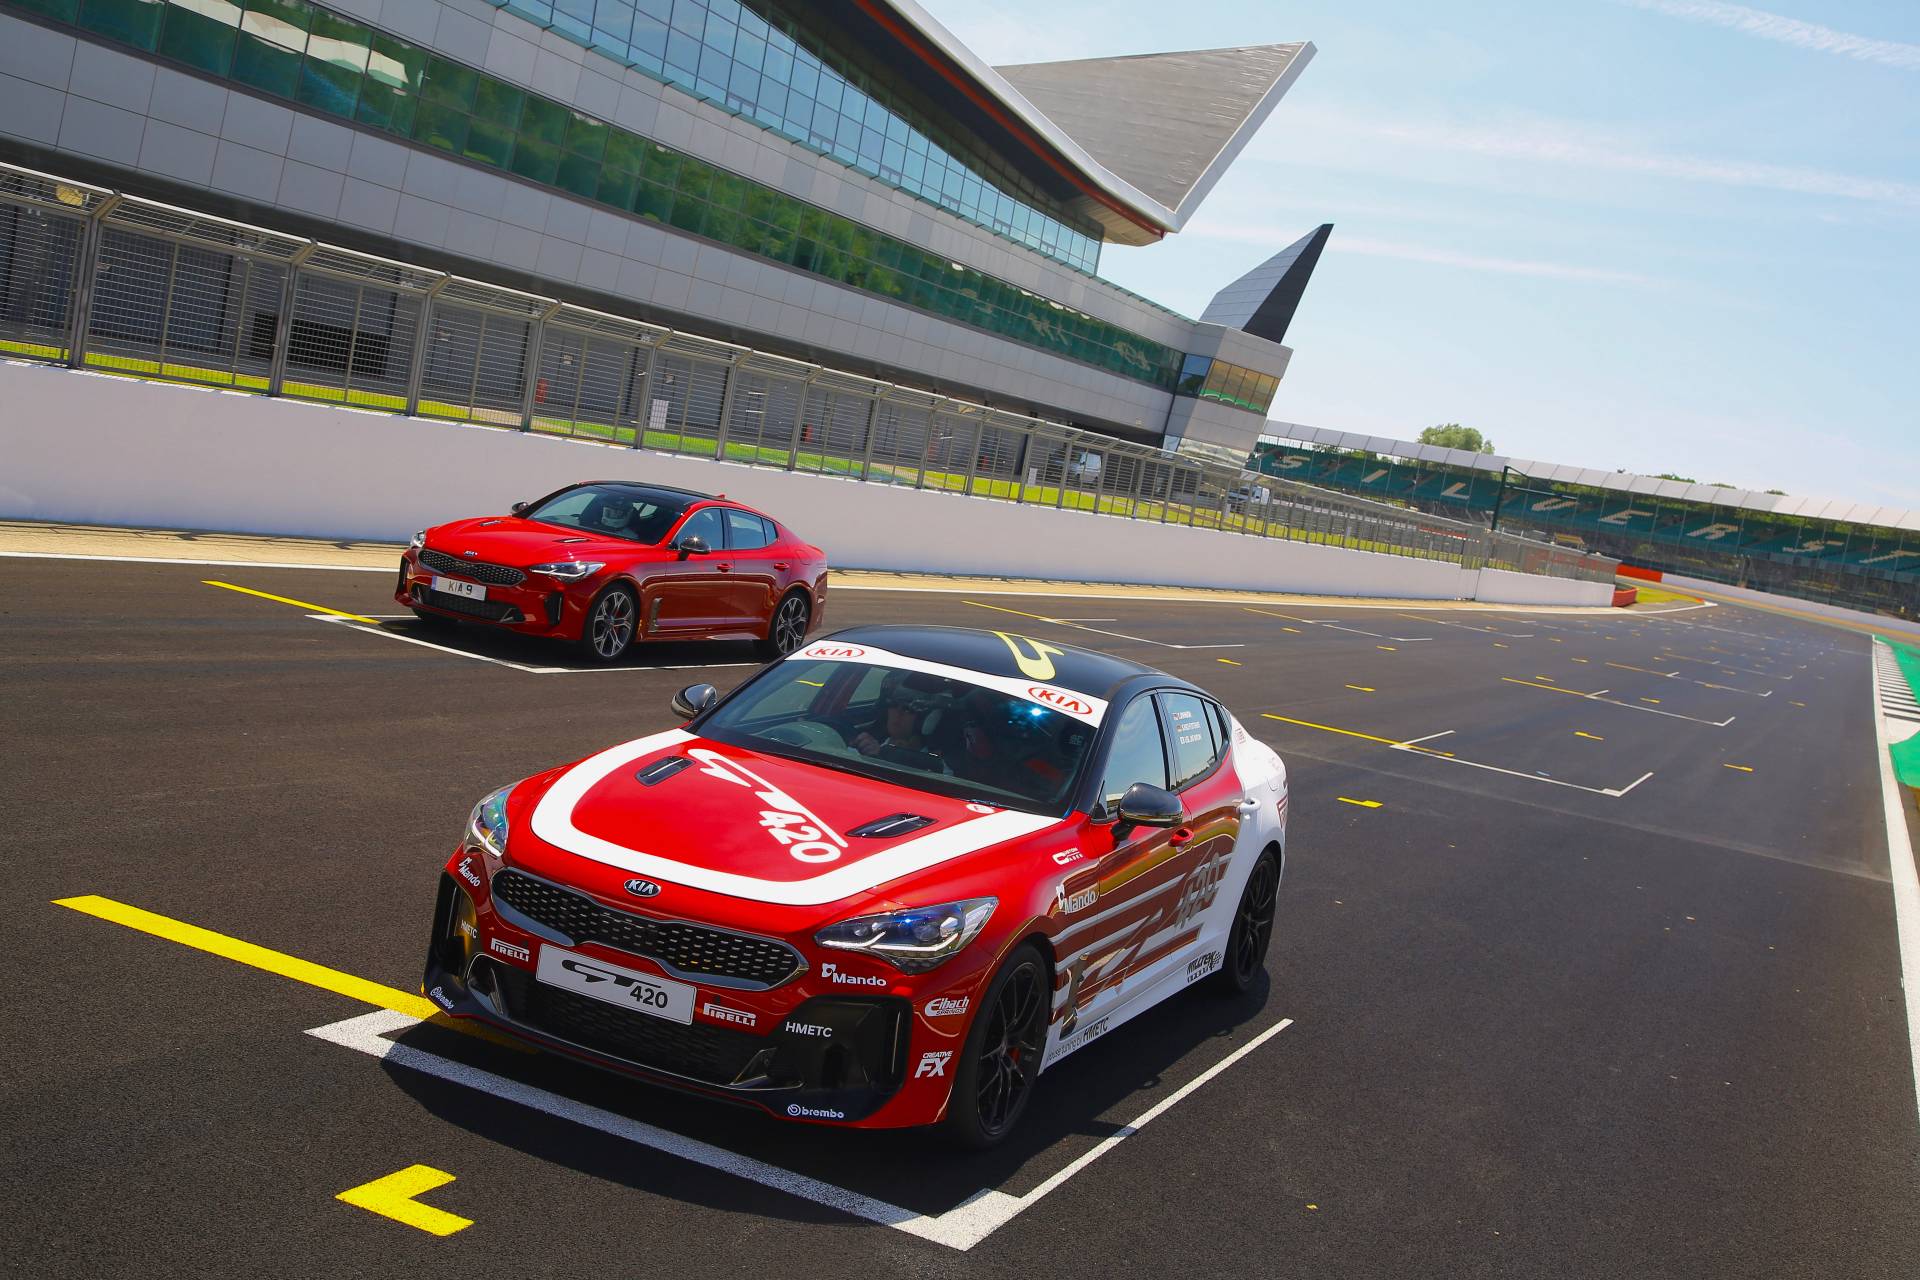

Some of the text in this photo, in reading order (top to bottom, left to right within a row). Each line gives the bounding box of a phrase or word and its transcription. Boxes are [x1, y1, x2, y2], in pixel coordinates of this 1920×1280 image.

[466, 584, 473, 595] 9
[814, 648, 853, 657] KIA
[1038, 689, 1080, 712] KIA
[758, 810, 841, 864] 420
[458, 865, 481, 887] Mando
[627, 880, 655, 894] KIA
[1063, 889, 1096, 915] Mando
[460, 919, 478, 939] HMETC
[490, 938, 530, 962] PIRELLI
[832, 971, 887, 987] Mando
[629, 985, 669, 1009] 420
[925, 996, 970, 1017] Eibach
[703, 1002, 756, 1027] PIRELLI
[785, 1021, 833, 1038] HMETC
[1083, 1017, 1109, 1041] HMETC
[922, 1051, 953, 1059] CREATIVE
[914, 1057, 951, 1079] FX
[801, 1106, 845, 1119] brembo
